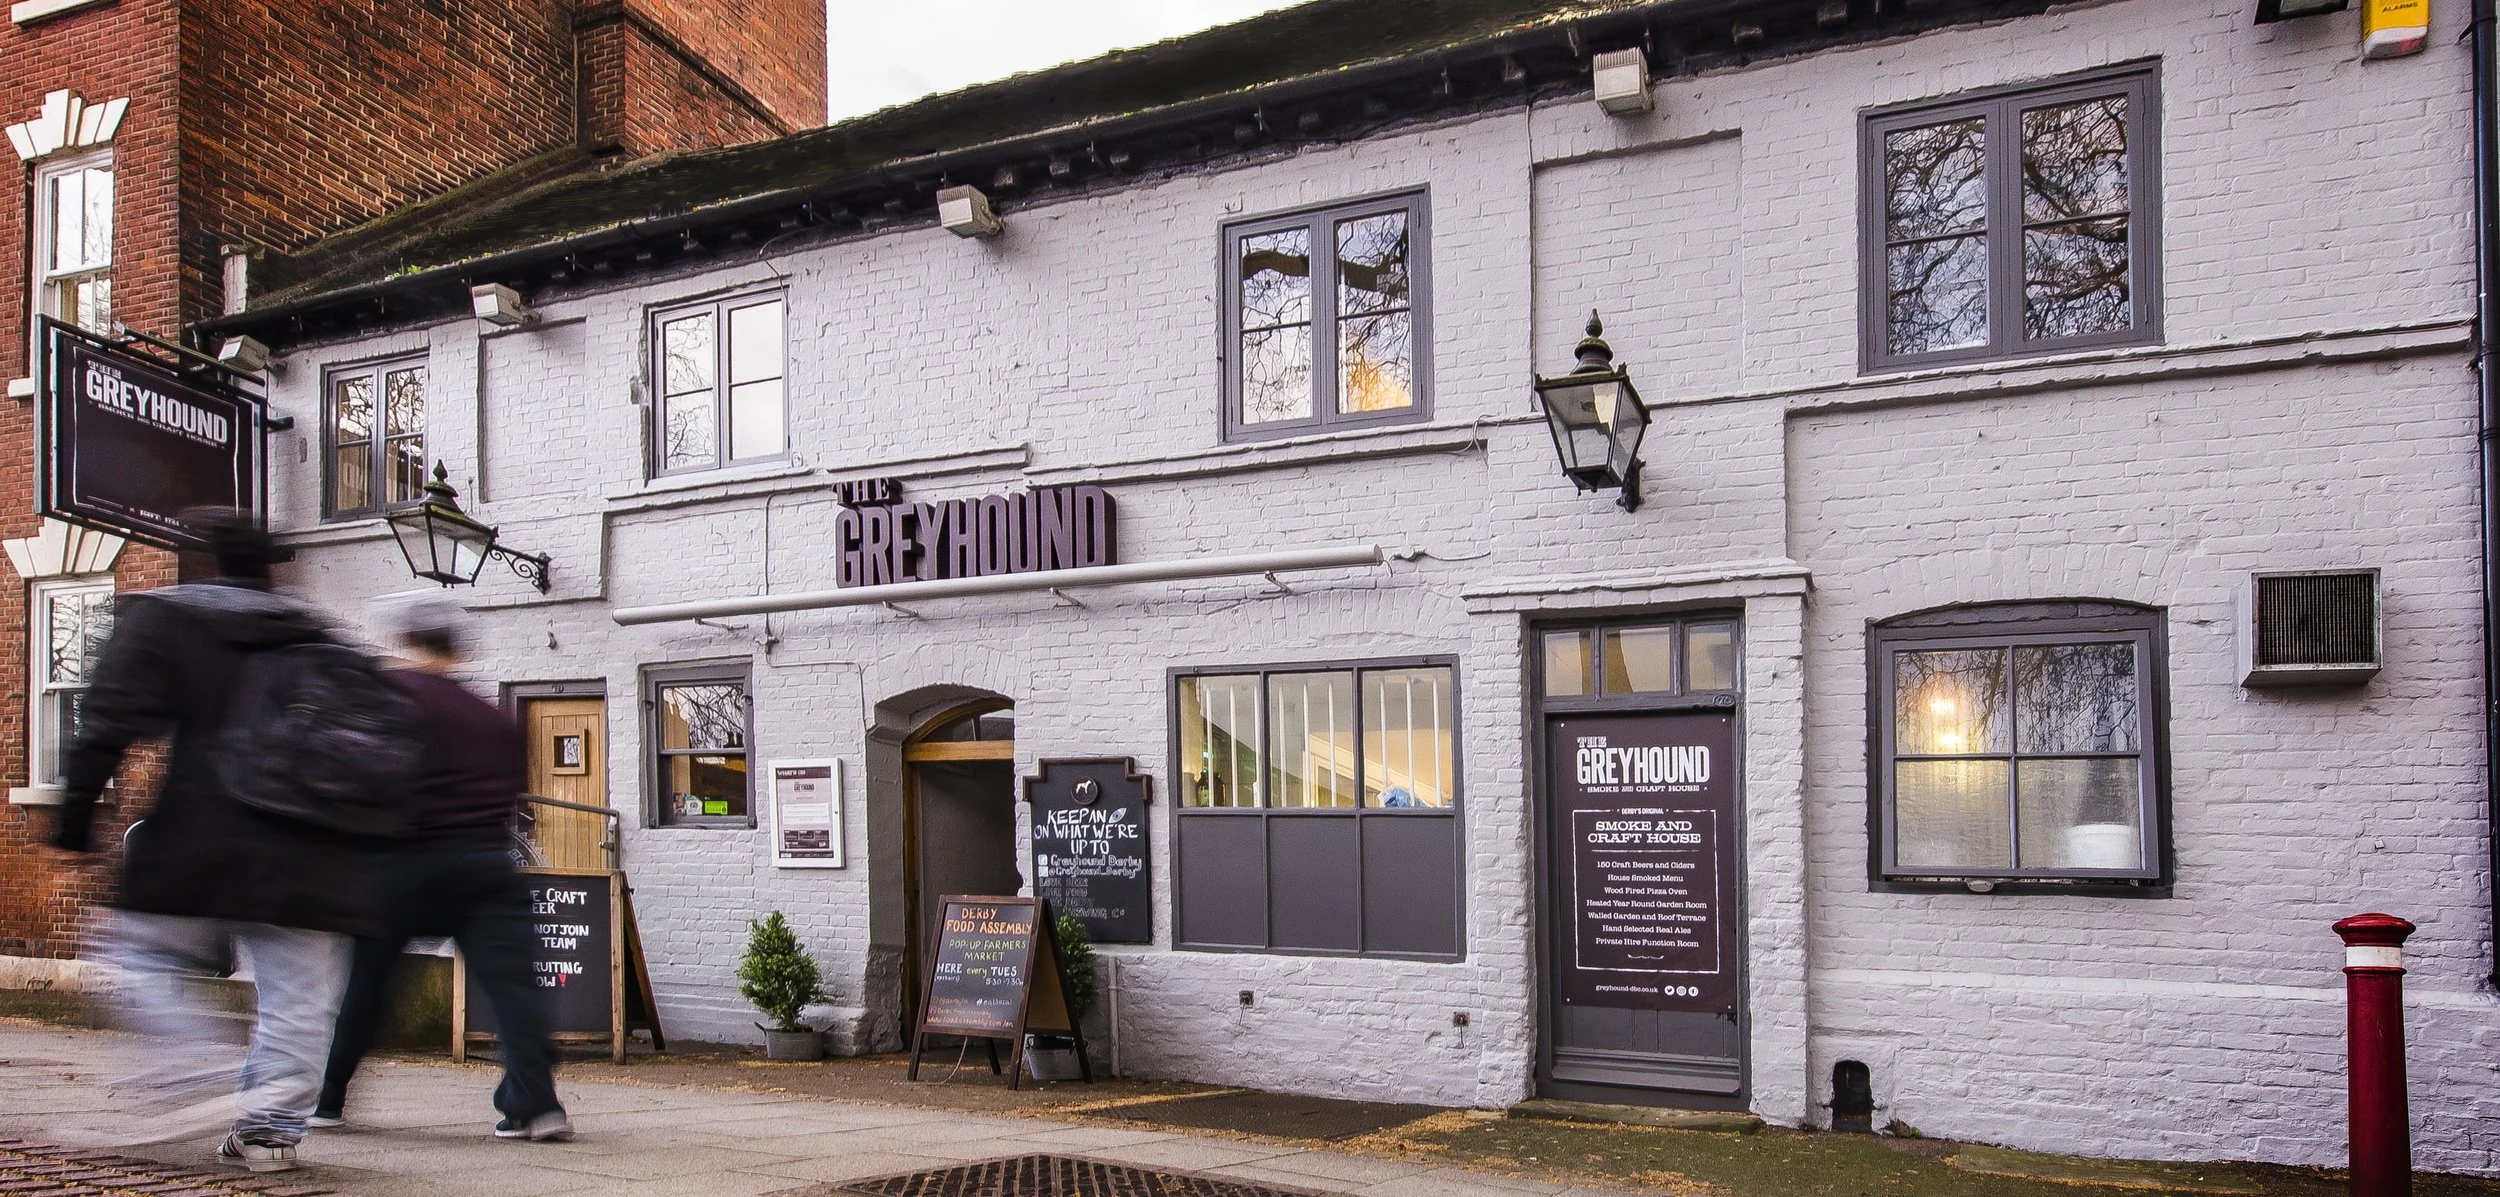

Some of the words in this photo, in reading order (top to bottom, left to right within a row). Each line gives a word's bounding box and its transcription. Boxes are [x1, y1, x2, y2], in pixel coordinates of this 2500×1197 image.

[2382, 2, 2419, 12] ALARMS
[86, 369, 228, 444] GREYHOUND
[833, 477, 896, 505] THE
[835, 484, 1112, 589] GREYHOUND
[1576, 736, 1607, 748] THE
[1576, 745, 1711, 785] GREYHOUND
[1587, 786, 1620, 794] SMOKE
[1635, 785, 1667, 793] CRAFT
[1048, 808, 1090, 824] KEEP
[1089, 808, 1107, 824] AN
[1034, 824, 1049, 840] ON
[1053, 824, 1090, 840] WHAT
[1093, 823, 1139, 840] WE'RE
[1595, 821, 1652, 831] SMOKE
[1655, 821, 1693, 831] AND
[1587, 833, 1643, 844] CRAFT
[1646, 833, 1701, 844] HOUSE
[1071, 840, 1088, 855] UP
[1089, 840, 1109, 855] TO
[1050, 854, 1105, 870] Greyhound
[1108, 855, 1142, 871] Derby
[1632, 861, 1654, 869] Beers
[1607, 874, 1630, 882] House
[1631, 874, 1661, 882] Smoked
[546, 888, 588, 905] CRAFT
[1604, 887, 1624, 895] Wood
[1624, 887, 1645, 895] Fired
[532, 902, 556, 914] EER
[1586, 899, 1612, 907] Heated
[1631, 900, 1655, 908] Round
[1656, 901, 1684, 909] Garden
[961, 907, 998, 920] DERBY
[1587, 911, 1612, 919] Walled
[1613, 912, 1641, 920] Garden
[1675, 914, 1706, 922] Terrace
[533, 924, 558, 935] NOT
[559, 923, 590, 937] JOIN
[946, 919, 975, 933] FOOD
[980, 921, 1032, 936] ASSEMBLY
[1674, 927, 1691, 935] Ales
[541, 937, 577, 950] TEAM
[949, 939, 981, 950] POP-UP
[983, 939, 1027, 950] FARMERS
[1595, 937, 1623, 945] Private
[1624, 938, 1641, 946] Hire
[1642, 939, 1676, 947] Function
[1677, 940, 1699, 948] Room
[964, 951, 1005, 962] MARKET
[533, 961, 583, 974] RUITING
[936, 963, 963, 975] HERE
[966, 966, 988, 980] every
[990, 966, 1017, 977] TUES
